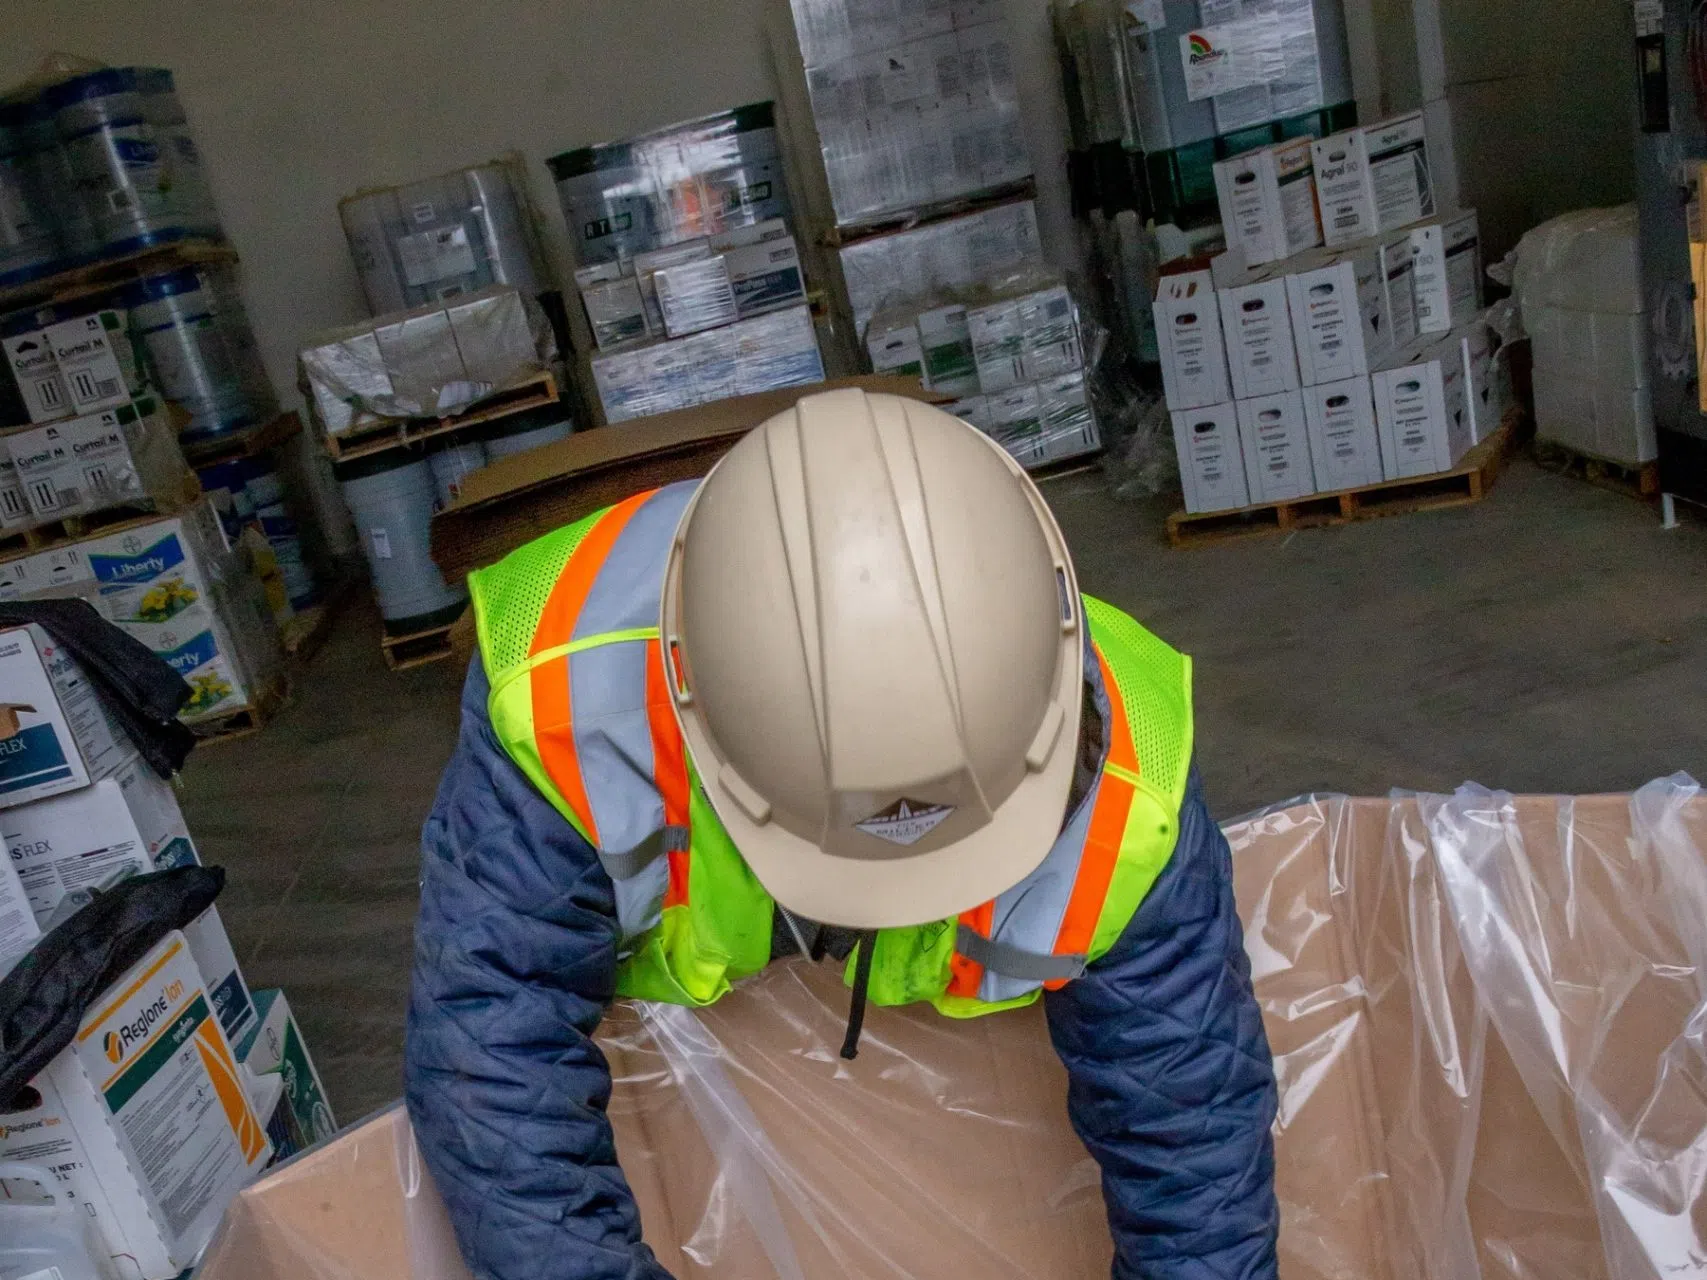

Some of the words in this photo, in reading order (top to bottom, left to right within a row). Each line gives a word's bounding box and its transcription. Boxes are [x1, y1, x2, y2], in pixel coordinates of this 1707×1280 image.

[1320, 161, 1345, 181] Agral
[58, 340, 93, 358] Curtail
[94, 337, 105, 349] M
[72, 437, 107, 453] Curtail
[108, 433, 119, 442] M
[17, 451, 51, 467] Curtail
[54, 447, 65, 457] M
[111, 556, 165, 578] Liberty
[166, 650, 200, 669] erty
[25, 839, 53, 857] FLEX
[58, 1162, 76, 1173] NET
